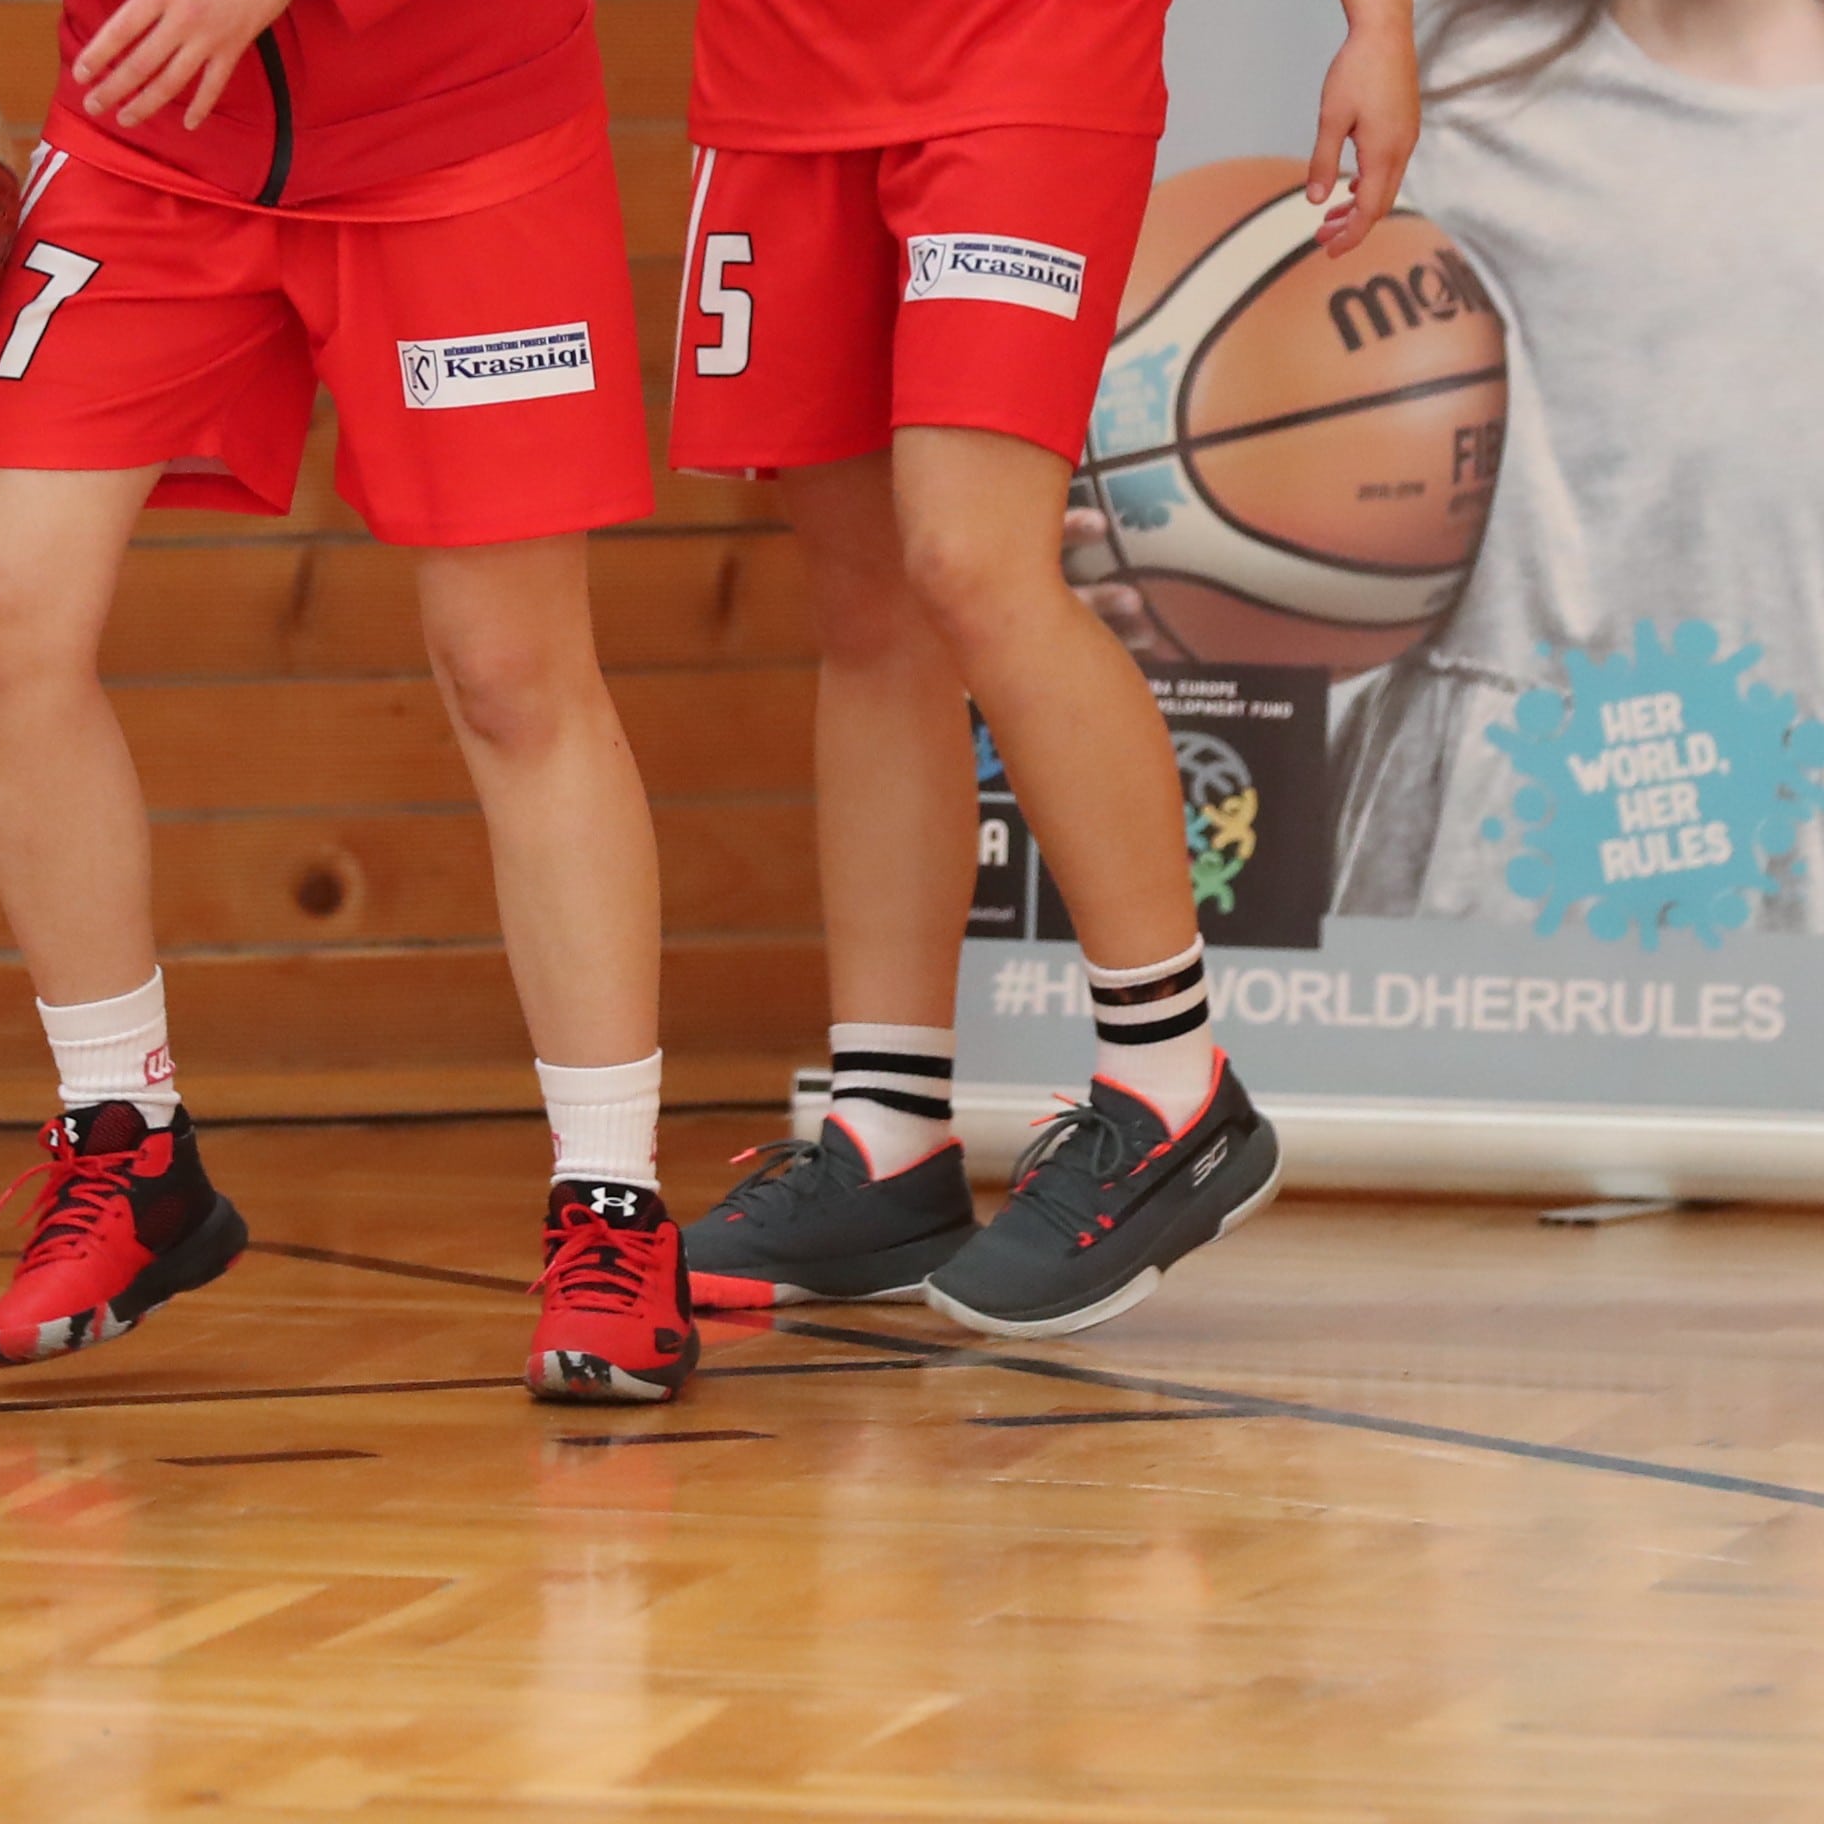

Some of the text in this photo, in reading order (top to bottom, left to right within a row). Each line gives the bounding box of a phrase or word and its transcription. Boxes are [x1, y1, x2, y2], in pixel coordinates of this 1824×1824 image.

[949, 252, 1080, 295] Krasniqi
[695, 231, 755, 378] 5
[445, 341, 590, 379] Krasniqi
[1600, 690, 1686, 745] HER
[1617, 780, 1703, 833] HER
[1598, 820, 1734, 884] RULES
